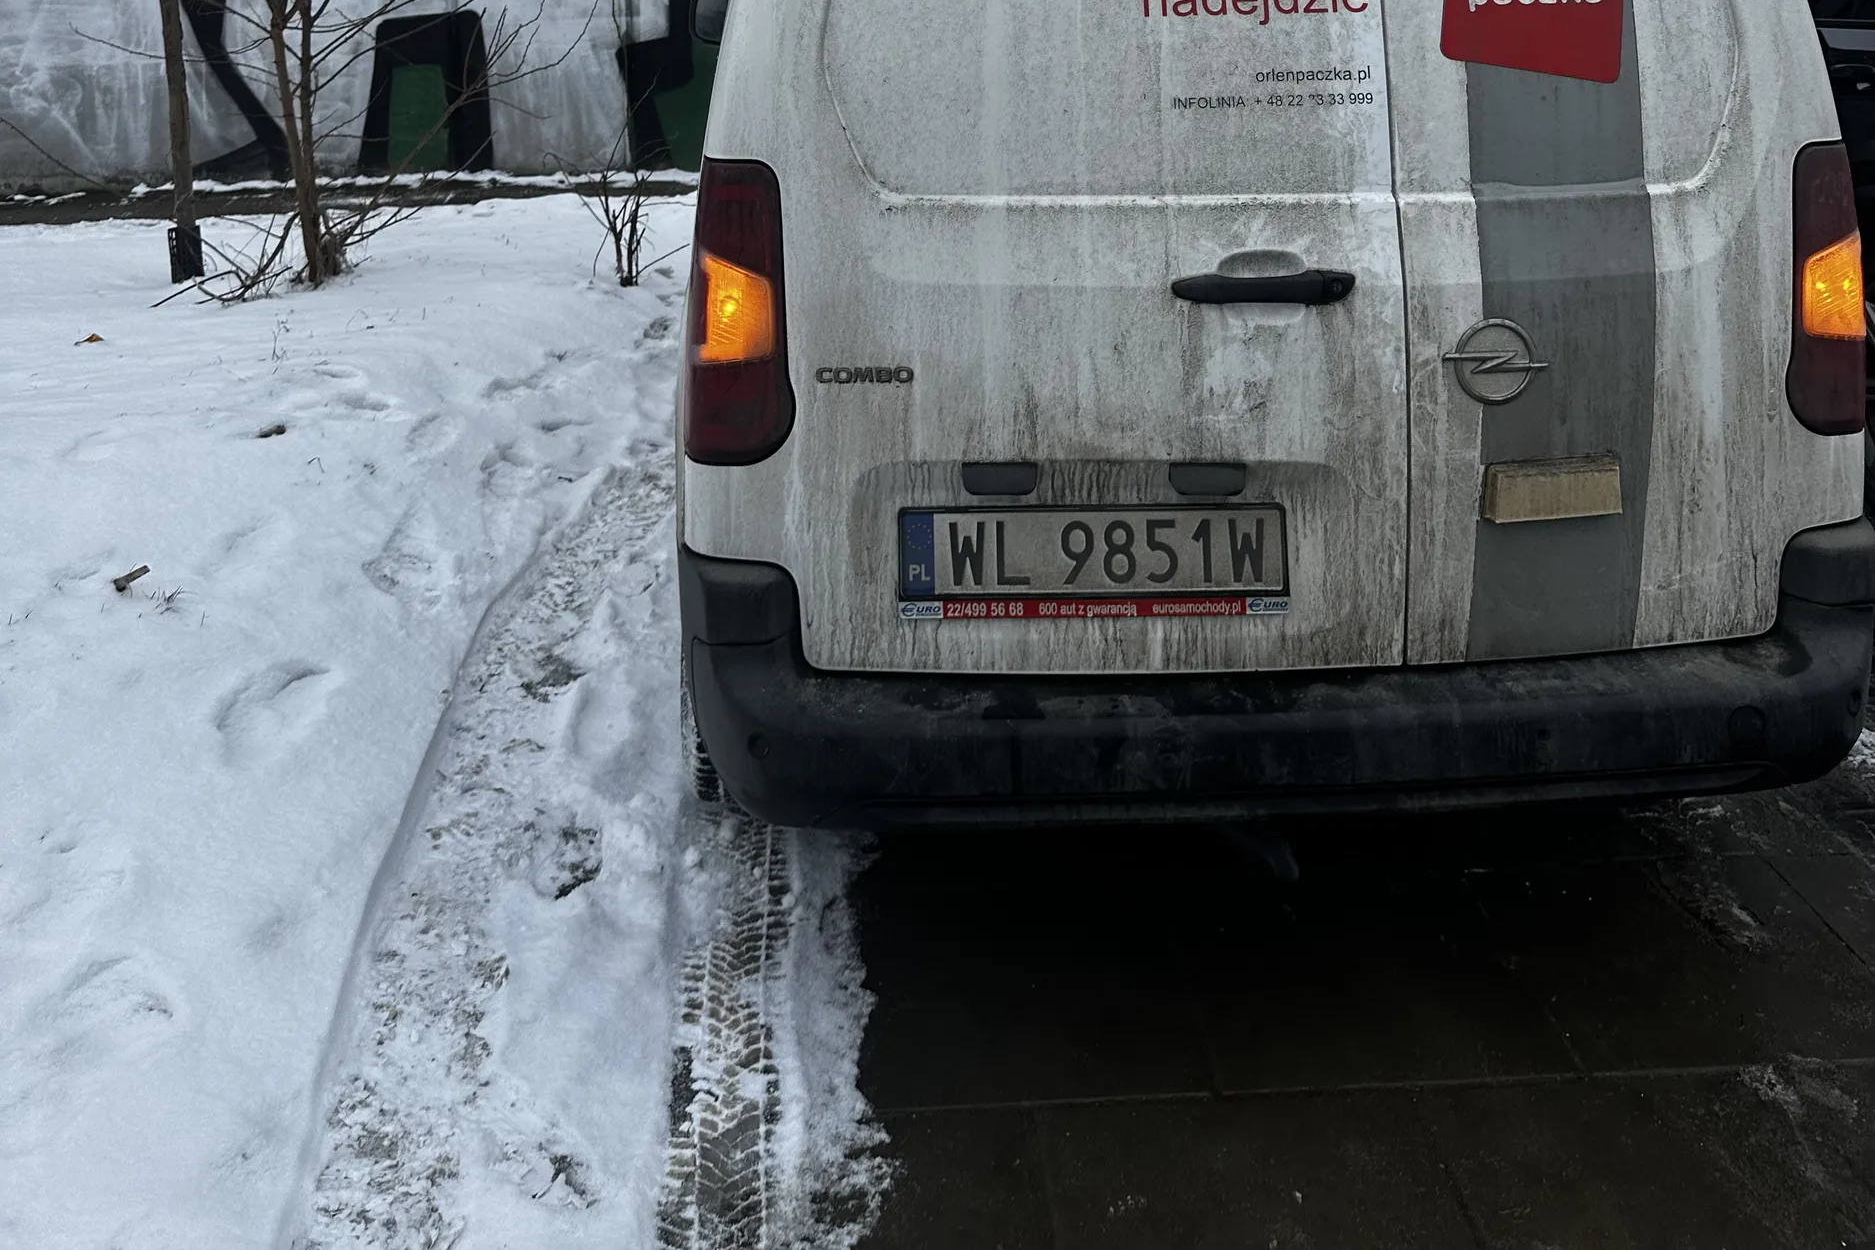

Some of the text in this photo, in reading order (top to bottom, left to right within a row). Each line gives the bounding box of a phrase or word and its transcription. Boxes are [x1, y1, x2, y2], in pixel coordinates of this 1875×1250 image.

[1255, 65, 1371, 84] orlenpaczka.pl
[1267, 94, 1283, 107] 48
[1287, 94, 1304, 106] 22
[1328, 93, 1345, 105] 33
[1349, 92, 1374, 105] 999
[816, 366, 914, 384] COMBO
[908, 518, 1264, 586] PL WL 9851W
[947, 602, 987, 617] 22/499
[990, 602, 1005, 616] 56
[1009, 602, 1024, 616] 68
[1039, 602, 1058, 615] 600
[1060, 602, 1076, 615] aut
[1077, 604, 1085, 615] z
[1086, 601, 1138, 617] gwarancją
[1152, 600, 1241, 615] eurosamochody.pl
